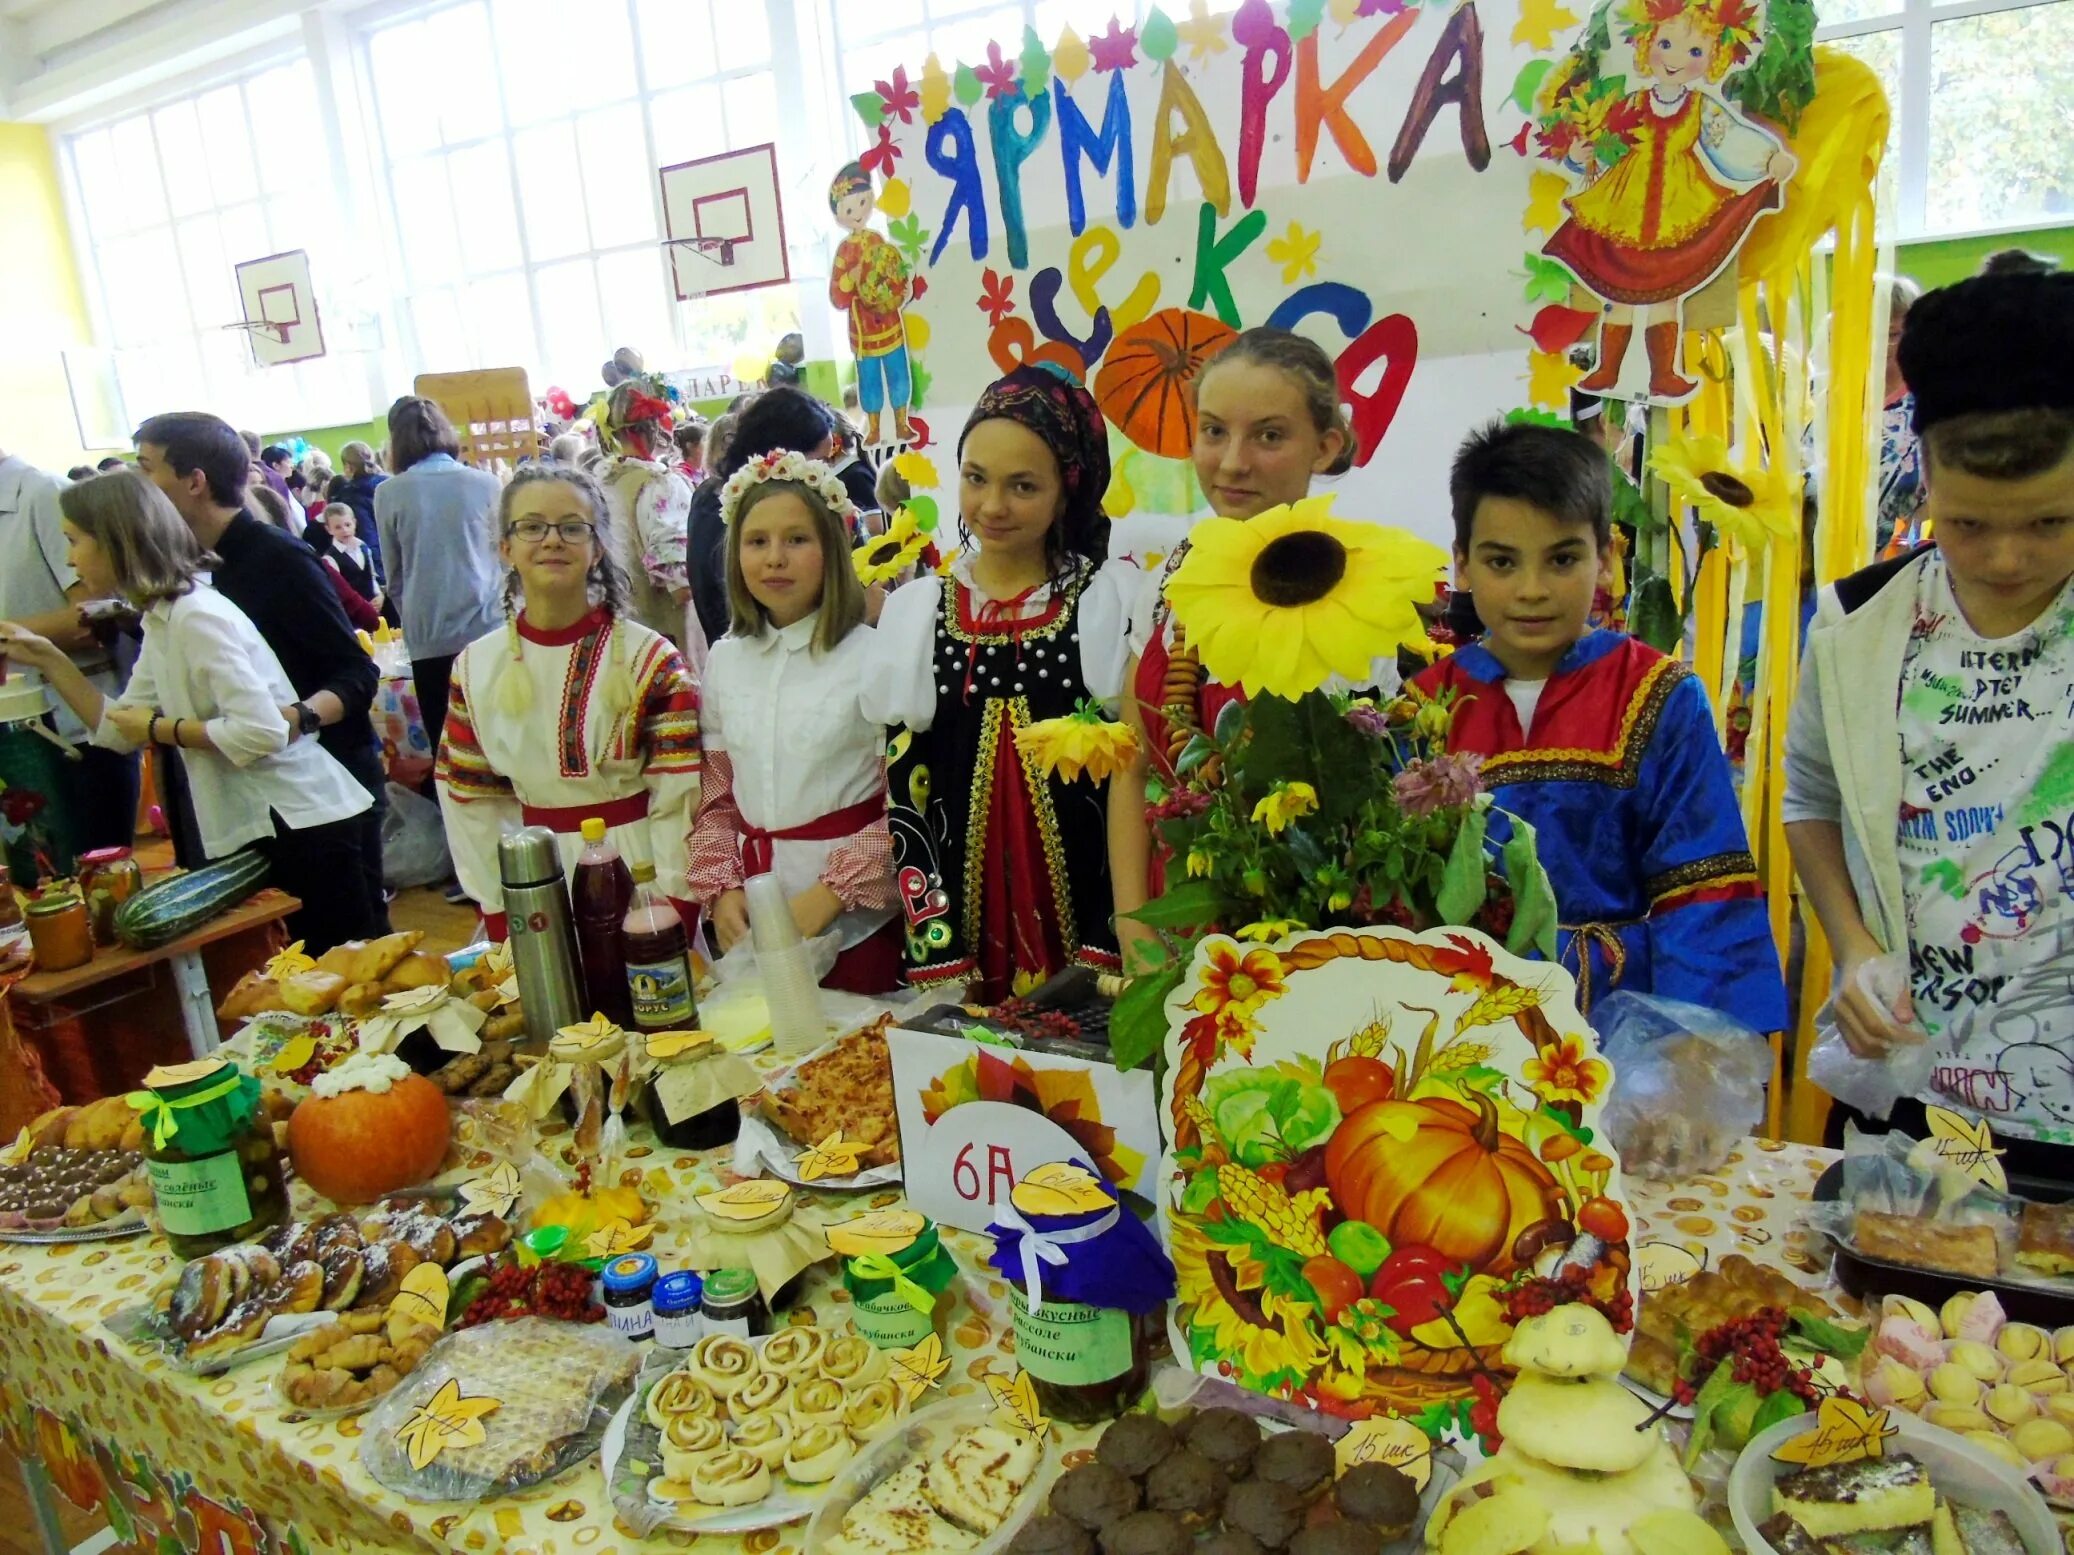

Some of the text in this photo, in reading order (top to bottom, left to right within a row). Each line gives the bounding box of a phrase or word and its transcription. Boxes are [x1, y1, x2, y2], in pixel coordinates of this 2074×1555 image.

[925, 1, 1491, 270] ЯРМАРКА
[1913, 747, 1964, 780] THE
[1353, 1431, 1388, 1462] 15
